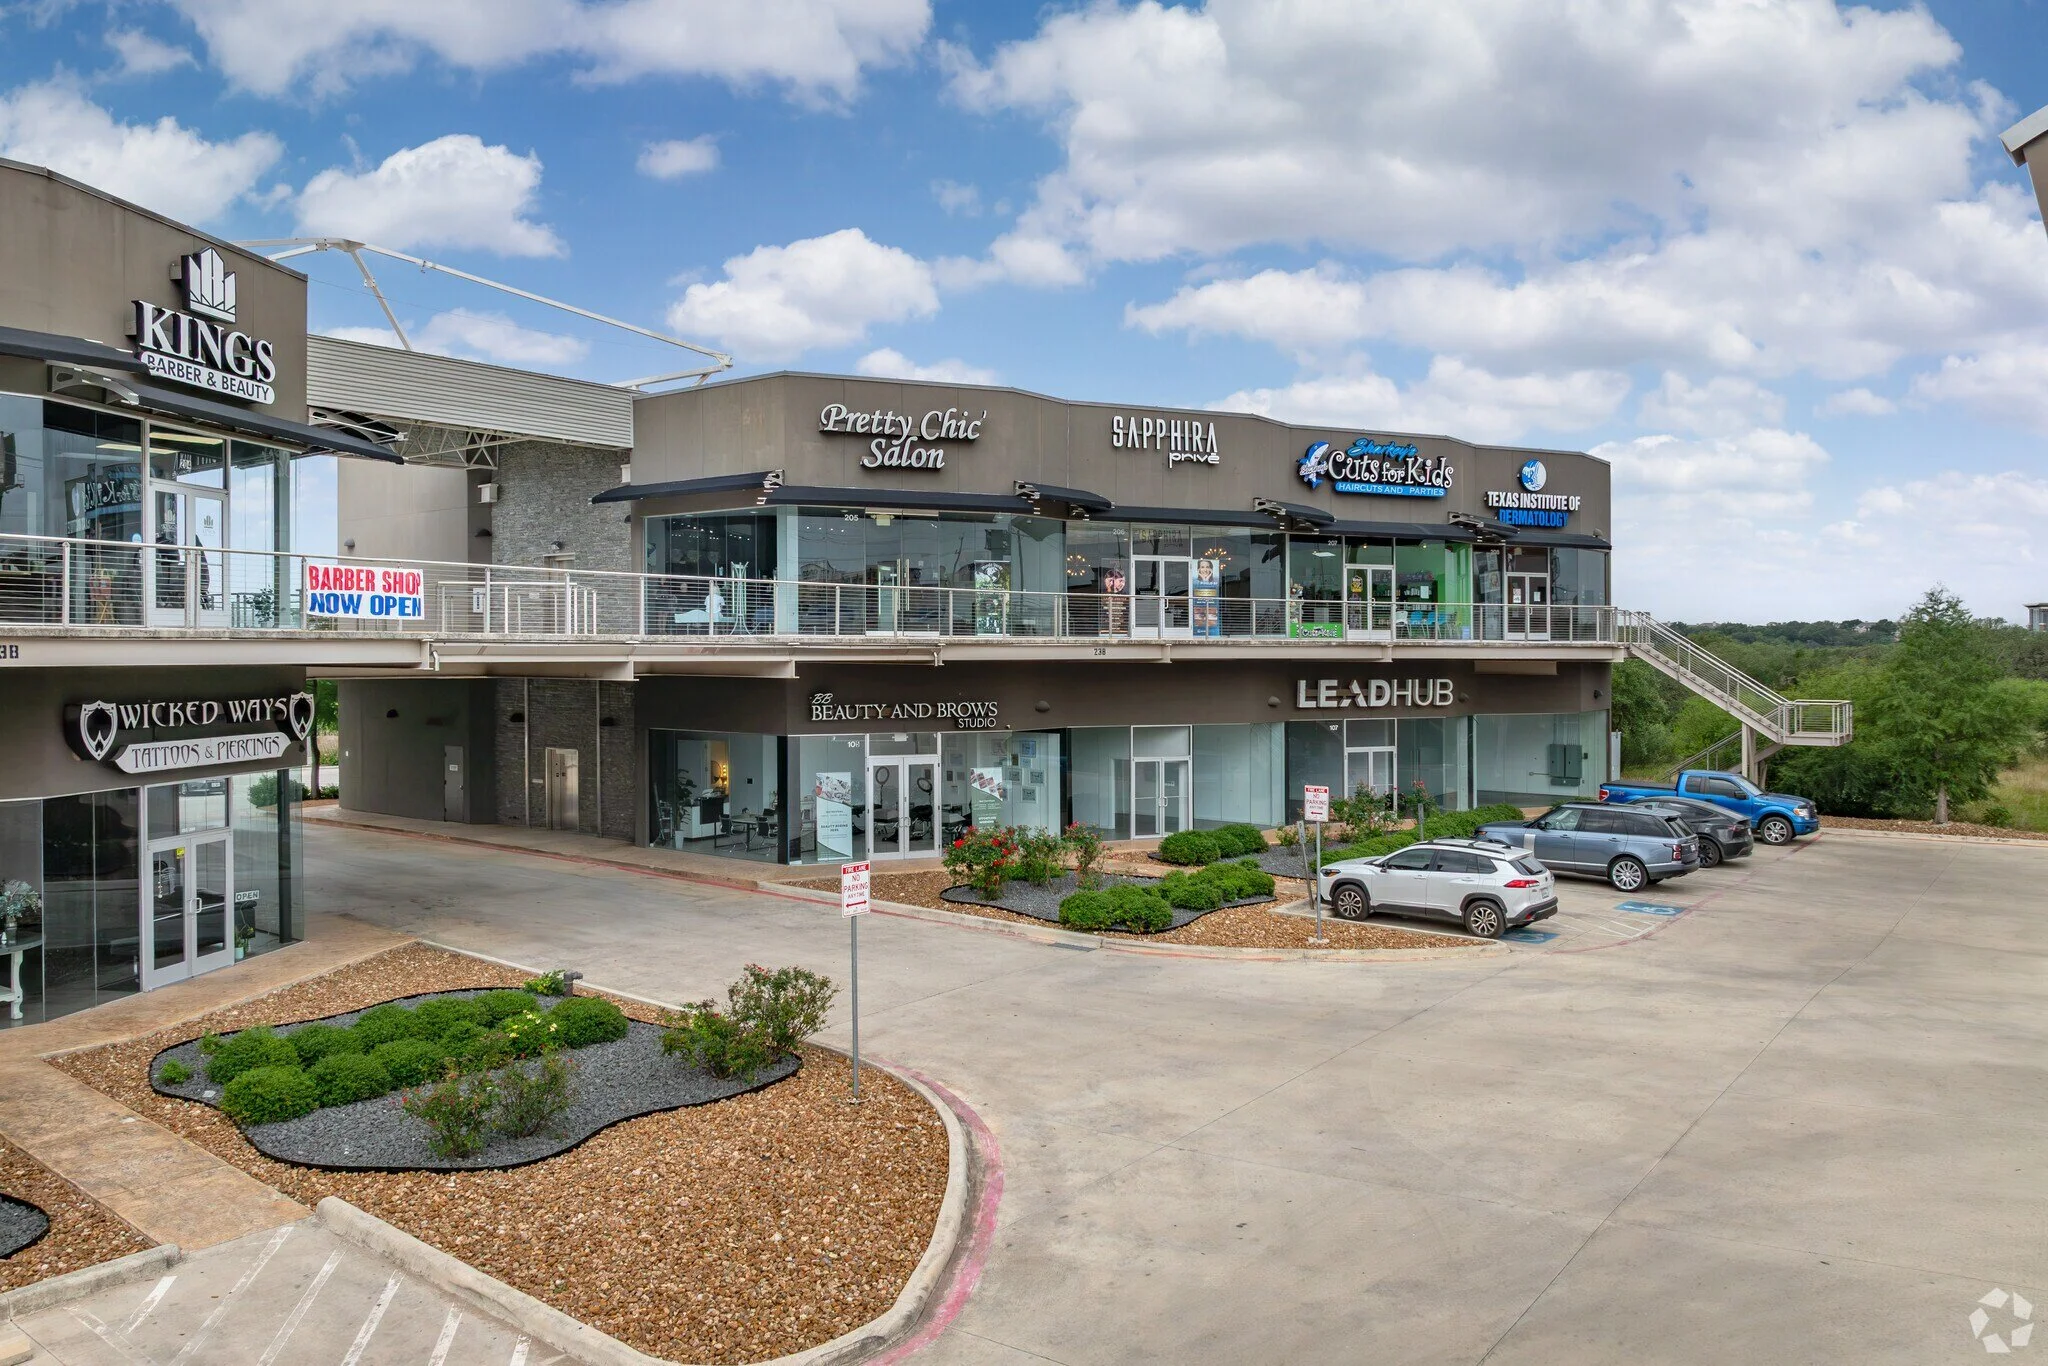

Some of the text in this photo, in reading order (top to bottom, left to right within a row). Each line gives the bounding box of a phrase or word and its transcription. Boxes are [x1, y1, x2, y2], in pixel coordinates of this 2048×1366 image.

[132, 300, 276, 383] KINGS
[147, 355, 269, 401] BARBER & BEAUTY
[820, 403, 913, 444] Pretty
[1113, 415, 1218, 453] SAPPHIRA
[860, 436, 945, 469] Salon
[1328, 450, 1380, 483] Cuts
[1382, 461, 1406, 483] for
[1405, 456, 1454, 488] Kids
[1339, 483, 1444, 496] HAIRCUTS AND PARTIES
[1487, 491, 1581, 511] TEXAS INSTITUTE OF
[1499, 509, 1569, 527] DERMATOLOGY
[308, 565, 421, 596] BARBER SHOP
[309, 592, 422, 617] NOW OPEN
[1093, 648, 1107, 656] 238
[1297, 678, 1454, 708] LEADHUB
[119, 697, 288, 730] WICKED WAYS
[811, 701, 998, 721] BEAUTY AND BROWS
[958, 718, 996, 728] STUDIO
[132, 736, 280, 768] TATTOOS & PIERCINGS
[856, 864, 867, 872] LANE
[236, 890, 259, 901] OPEN
[844, 882, 869, 893] PARKING
